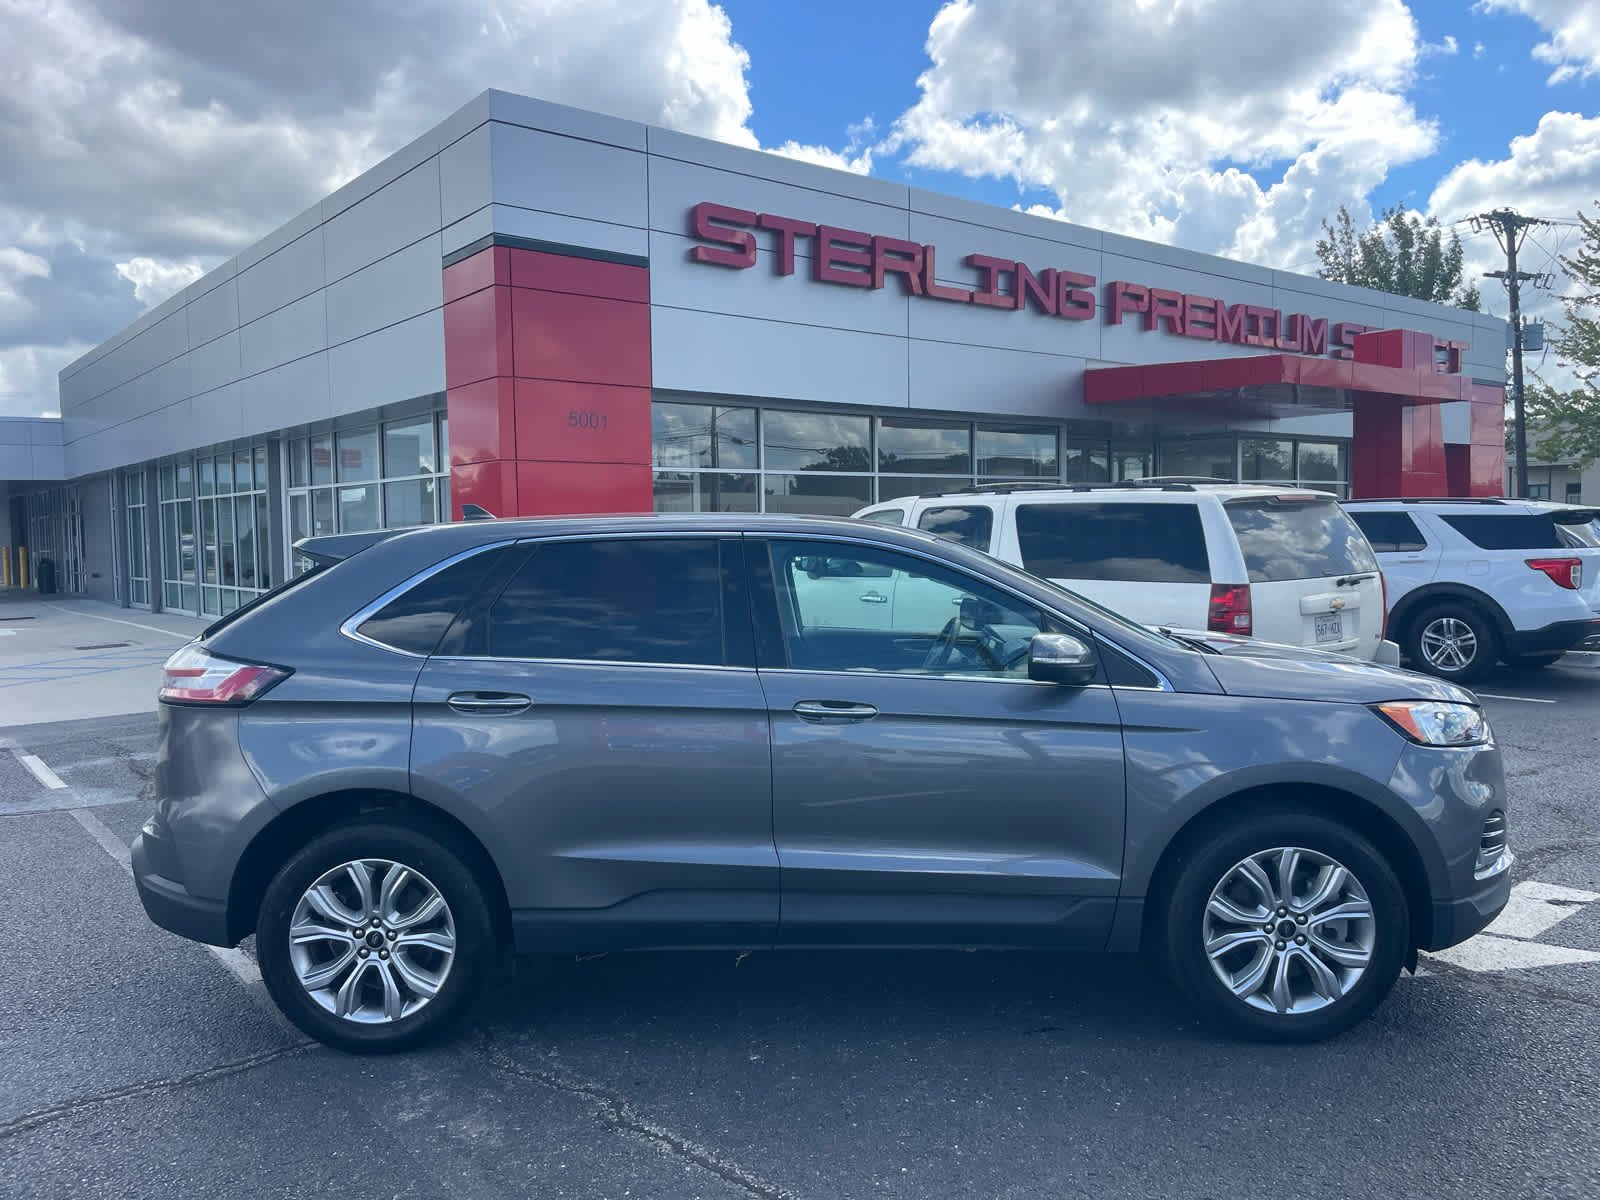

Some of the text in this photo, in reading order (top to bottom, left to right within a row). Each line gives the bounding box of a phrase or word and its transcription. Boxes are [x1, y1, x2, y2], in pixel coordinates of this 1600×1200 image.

[690, 202, 1470, 373] STERLING PREMIUM SCT
[568, 410, 608, 431] 5001
